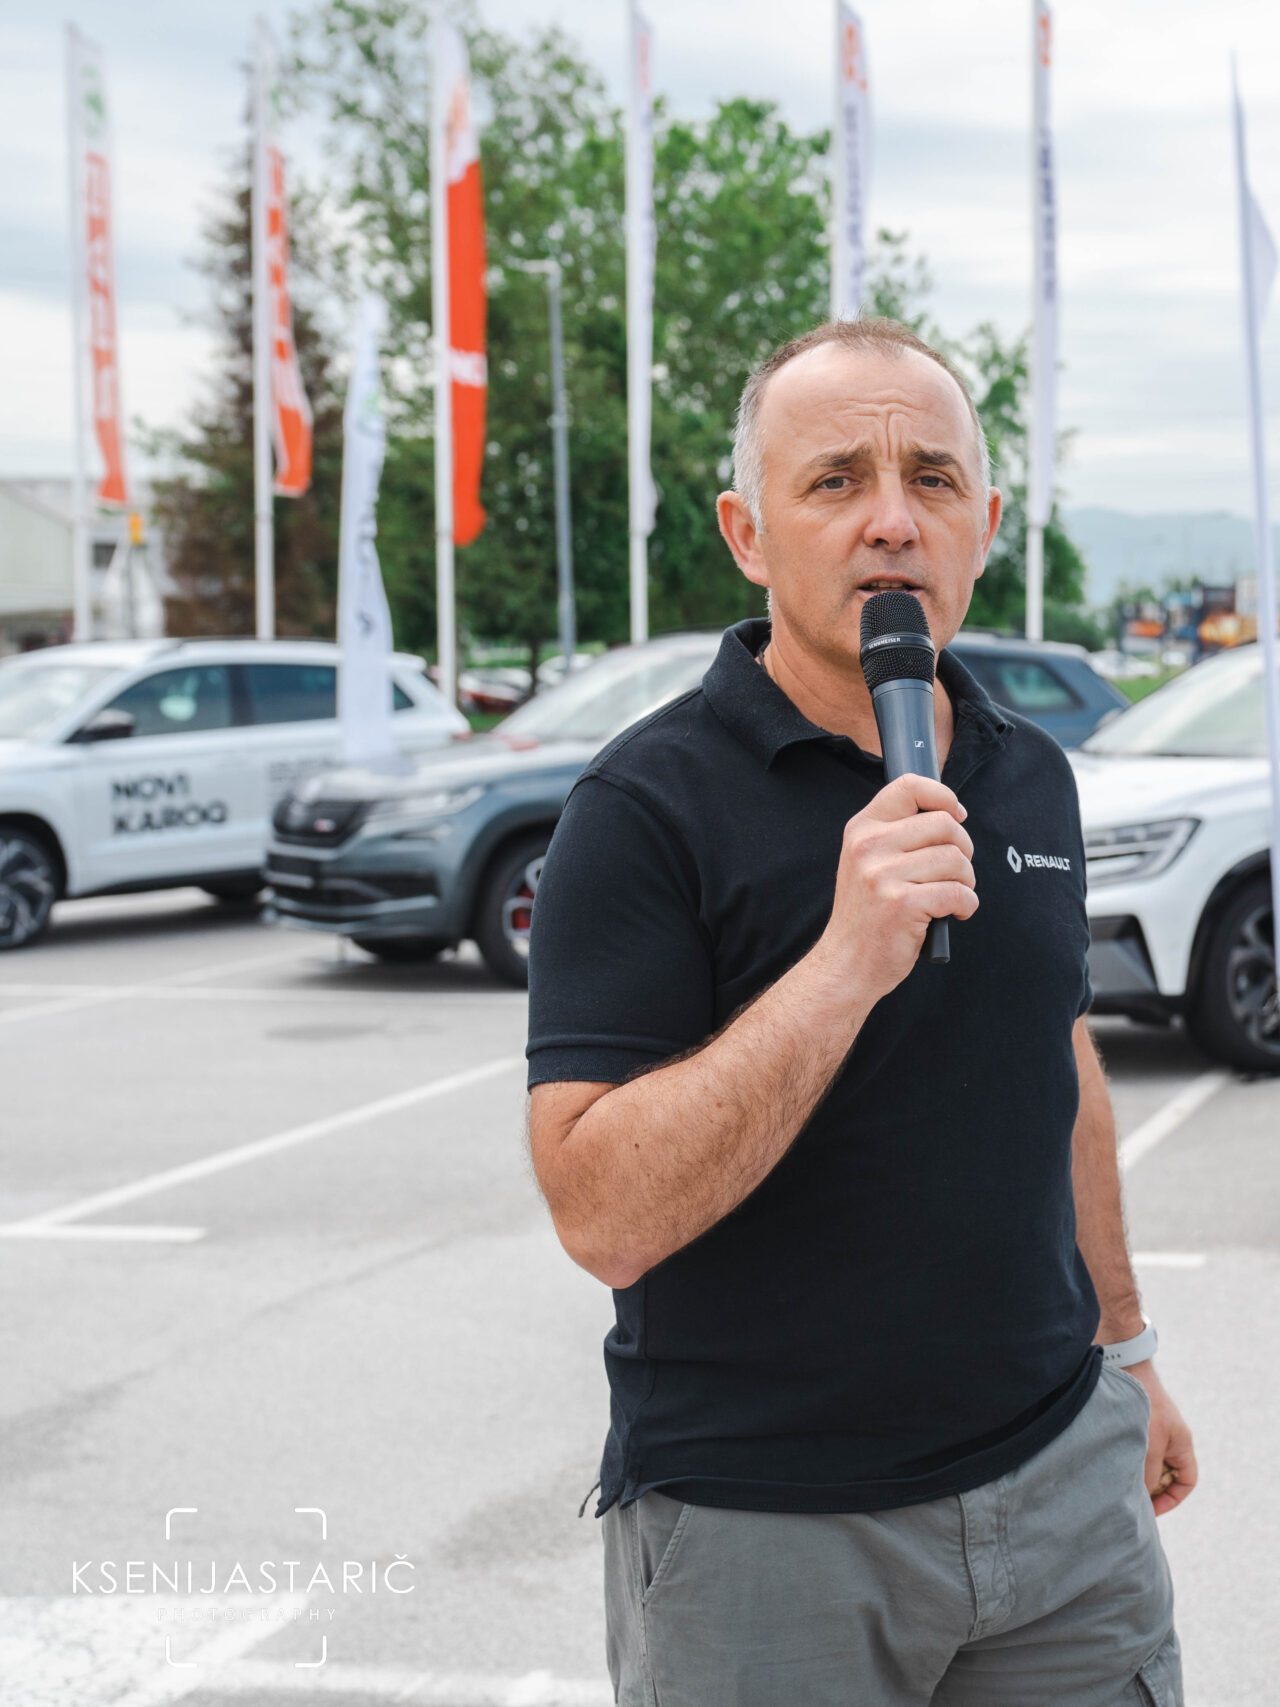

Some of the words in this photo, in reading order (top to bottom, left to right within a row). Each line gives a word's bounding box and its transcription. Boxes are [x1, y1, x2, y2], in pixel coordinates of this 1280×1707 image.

[111, 772, 190, 800] NOVI
[112, 801, 228, 836] KAROQ
[1024, 853, 1071, 871] RENAULT
